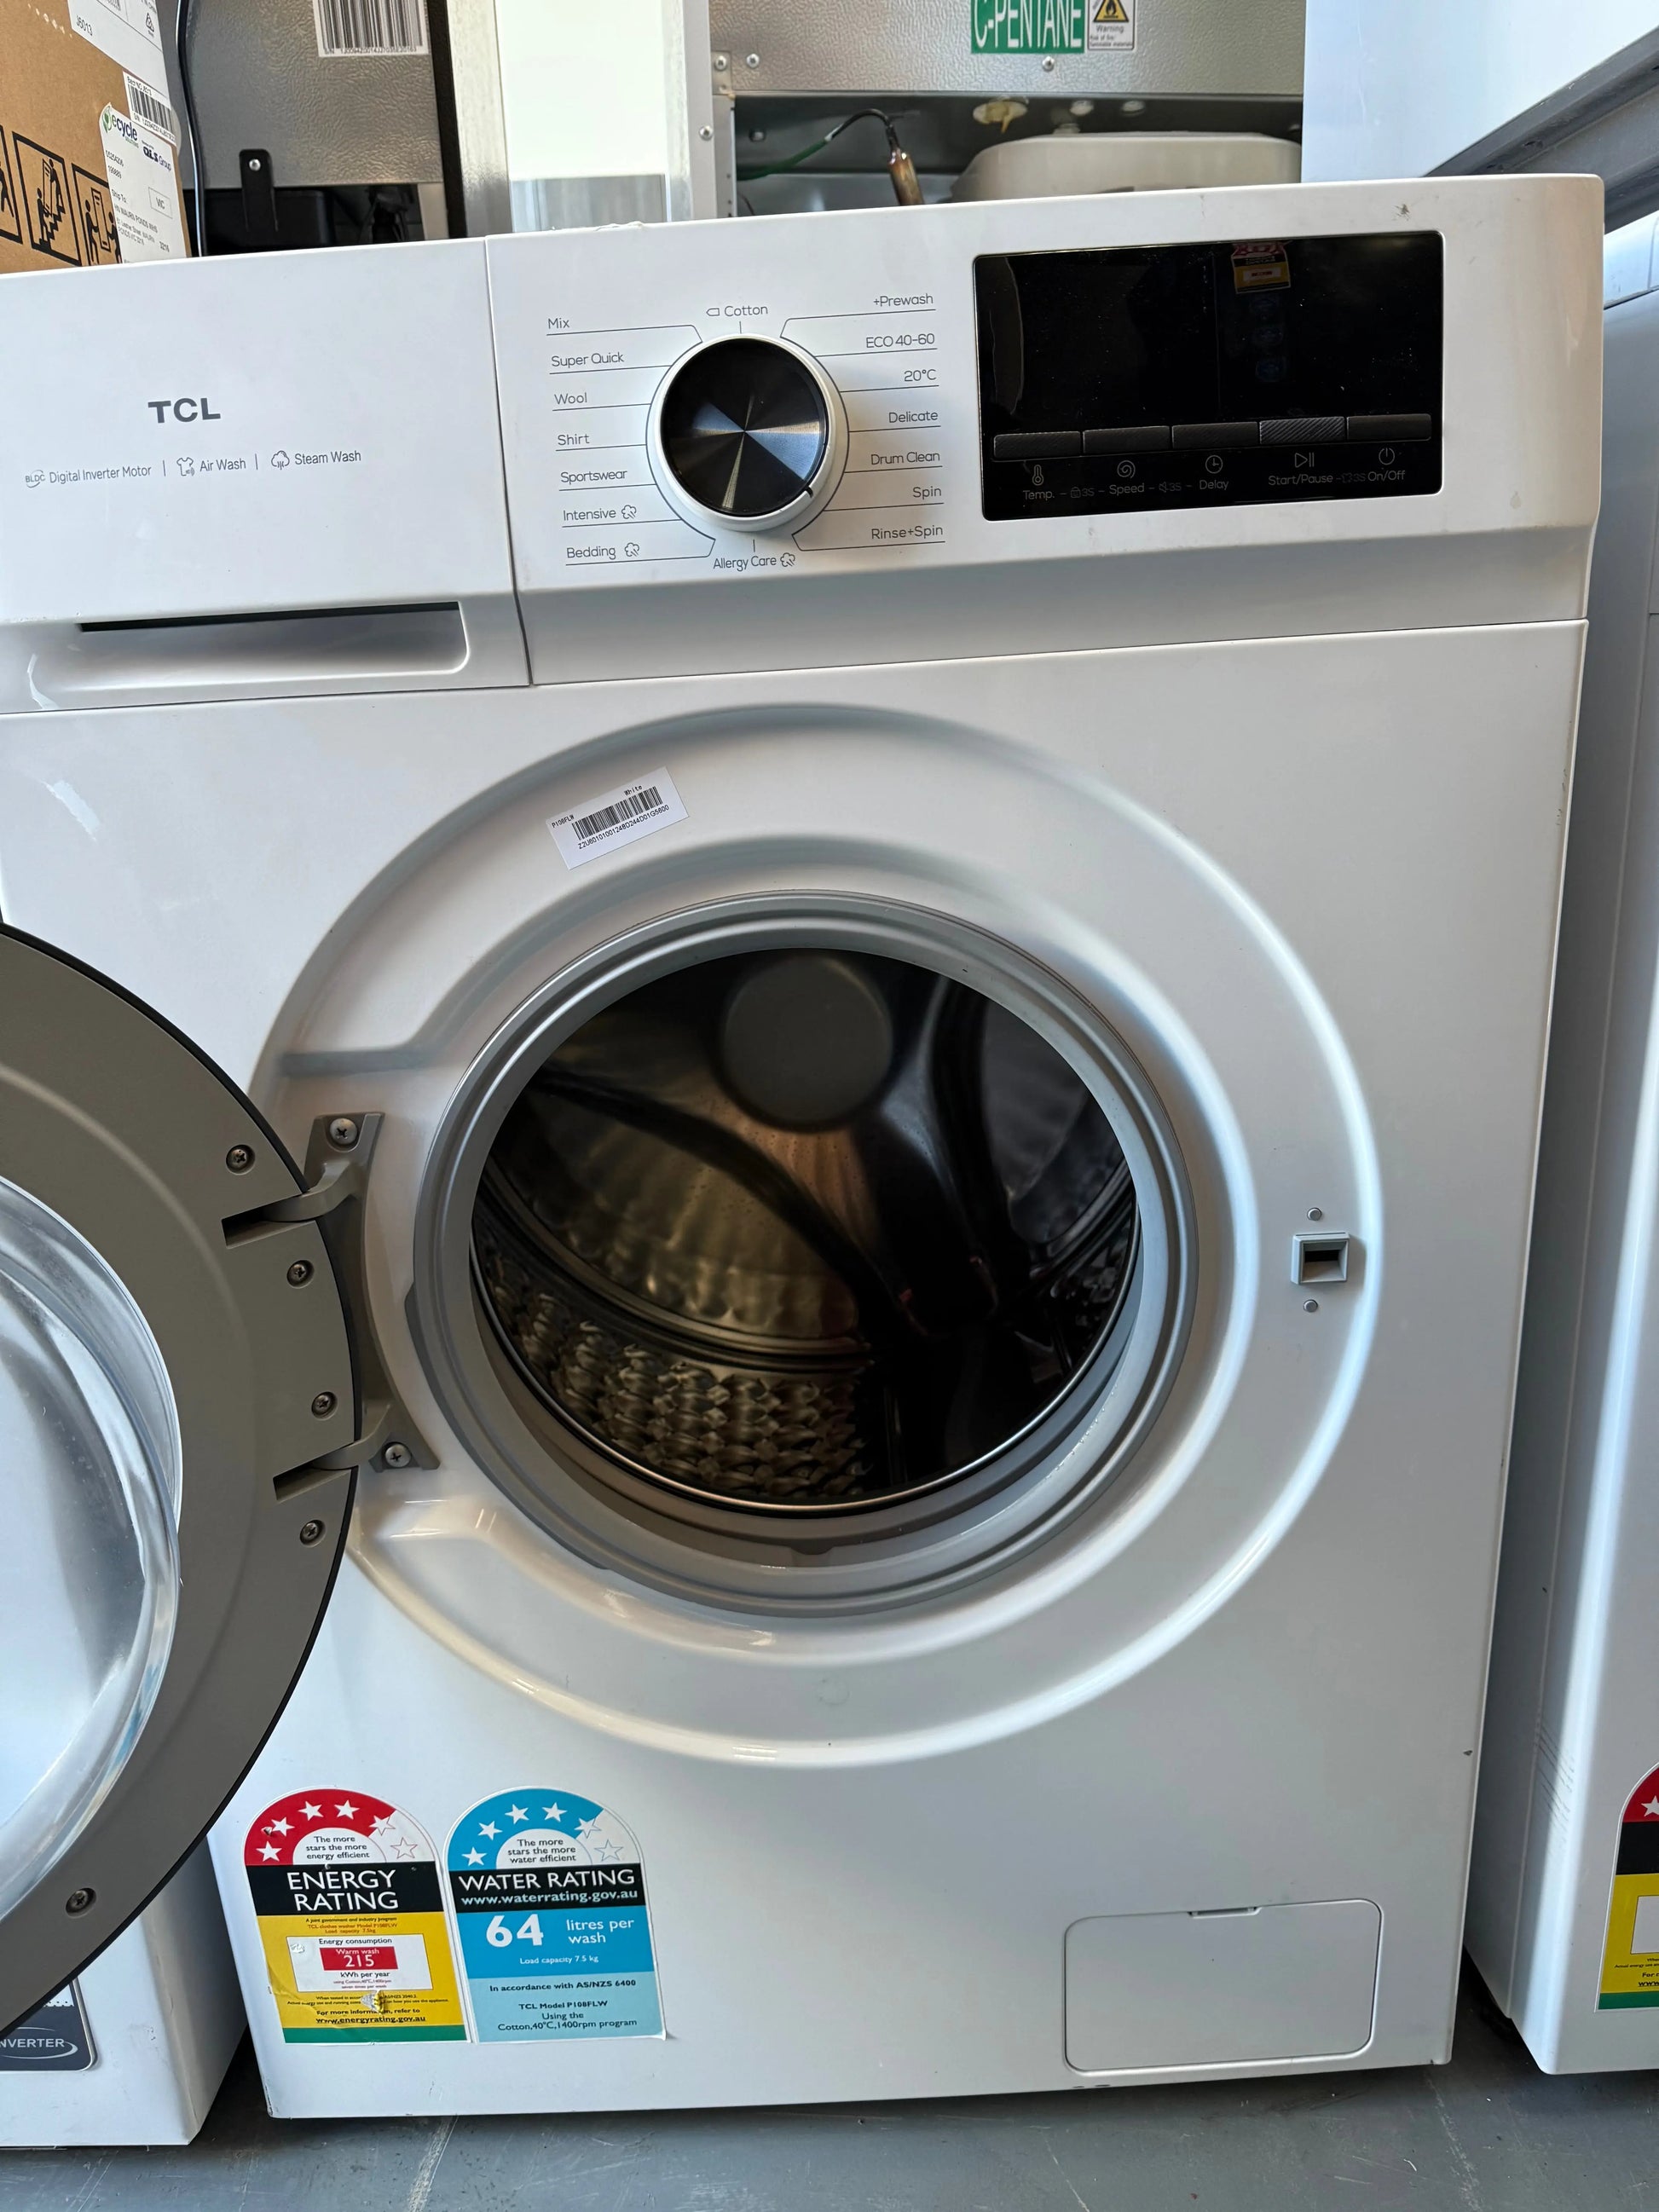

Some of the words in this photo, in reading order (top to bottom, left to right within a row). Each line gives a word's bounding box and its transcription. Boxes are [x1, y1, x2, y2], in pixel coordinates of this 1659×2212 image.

[1095, 25, 1124, 34] Warning
[159, 155, 172, 172] Group
[155, 197, 165, 210] VIC
[874, 293, 934, 307] +Prewash
[724, 305, 769, 317] Cotton
[547, 317, 570, 329] Mix
[866, 336, 893, 348] ECO
[895, 333, 935, 346] 40-60
[552, 355, 589, 368] Super
[591, 352, 625, 364] Quick
[904, 368, 937, 382] 20°C
[554, 392, 587, 405] Wool
[147, 397, 222, 424] TCL
[888, 411, 939, 424] Delicate
[558, 434, 590, 446] Shirt
[294, 453, 328, 465] Steam
[331, 450, 361, 463] Wash
[871, 453, 905, 465] Drum
[906, 452, 940, 463] Clean
[199, 459, 214, 471] Air
[217, 458, 246, 471] Wash
[25, 474, 46, 483] BLDC
[49, 470, 81, 484] Digital
[83, 467, 120, 481] Inverter
[123, 466, 152, 478] Motor
[560, 470, 627, 485] Sportswear
[1268, 472, 1333, 487] Start/Pause
[1367, 470, 1406, 482] On/Off
[913, 486, 942, 500] Spin
[1023, 490, 1055, 501] Temp.
[1109, 482, 1145, 496] Speed
[1199, 479, 1229, 491] Delay
[564, 508, 616, 521] Intensive
[871, 525, 943, 540] Rinse+Spin
[566, 546, 616, 560] Bedding
[713, 557, 749, 572] Allergy
[751, 556, 777, 567] Care
[623, 784, 643, 796] White
[540, 1854, 576, 1863] efficient
[286, 1869, 396, 1890] ENERGY
[458, 1874, 541, 1891] WATER
[547, 1868, 635, 1888] RATING
[294, 1891, 399, 1911] RATING
[461, 1891, 638, 1905] www.waterrating.gov.au
[486, 1914, 544, 1948] 64
[566, 1919, 604, 1931] litres
[609, 1919, 635, 1932] per
[568, 1932, 606, 1944] wash
[344, 1954, 375, 1967] 215
[541, 1956, 573, 1965] capacity
[589, 1955, 599, 1963] kg
[576, 1980, 612, 1989] AS/NZS
[567, 2000, 608, 2008] P108FLW
[315, 2015, 426, 2024] www.energyrating.gov.au
[541, 2013, 567, 2021] Using
[599, 2019, 638, 2028] program
